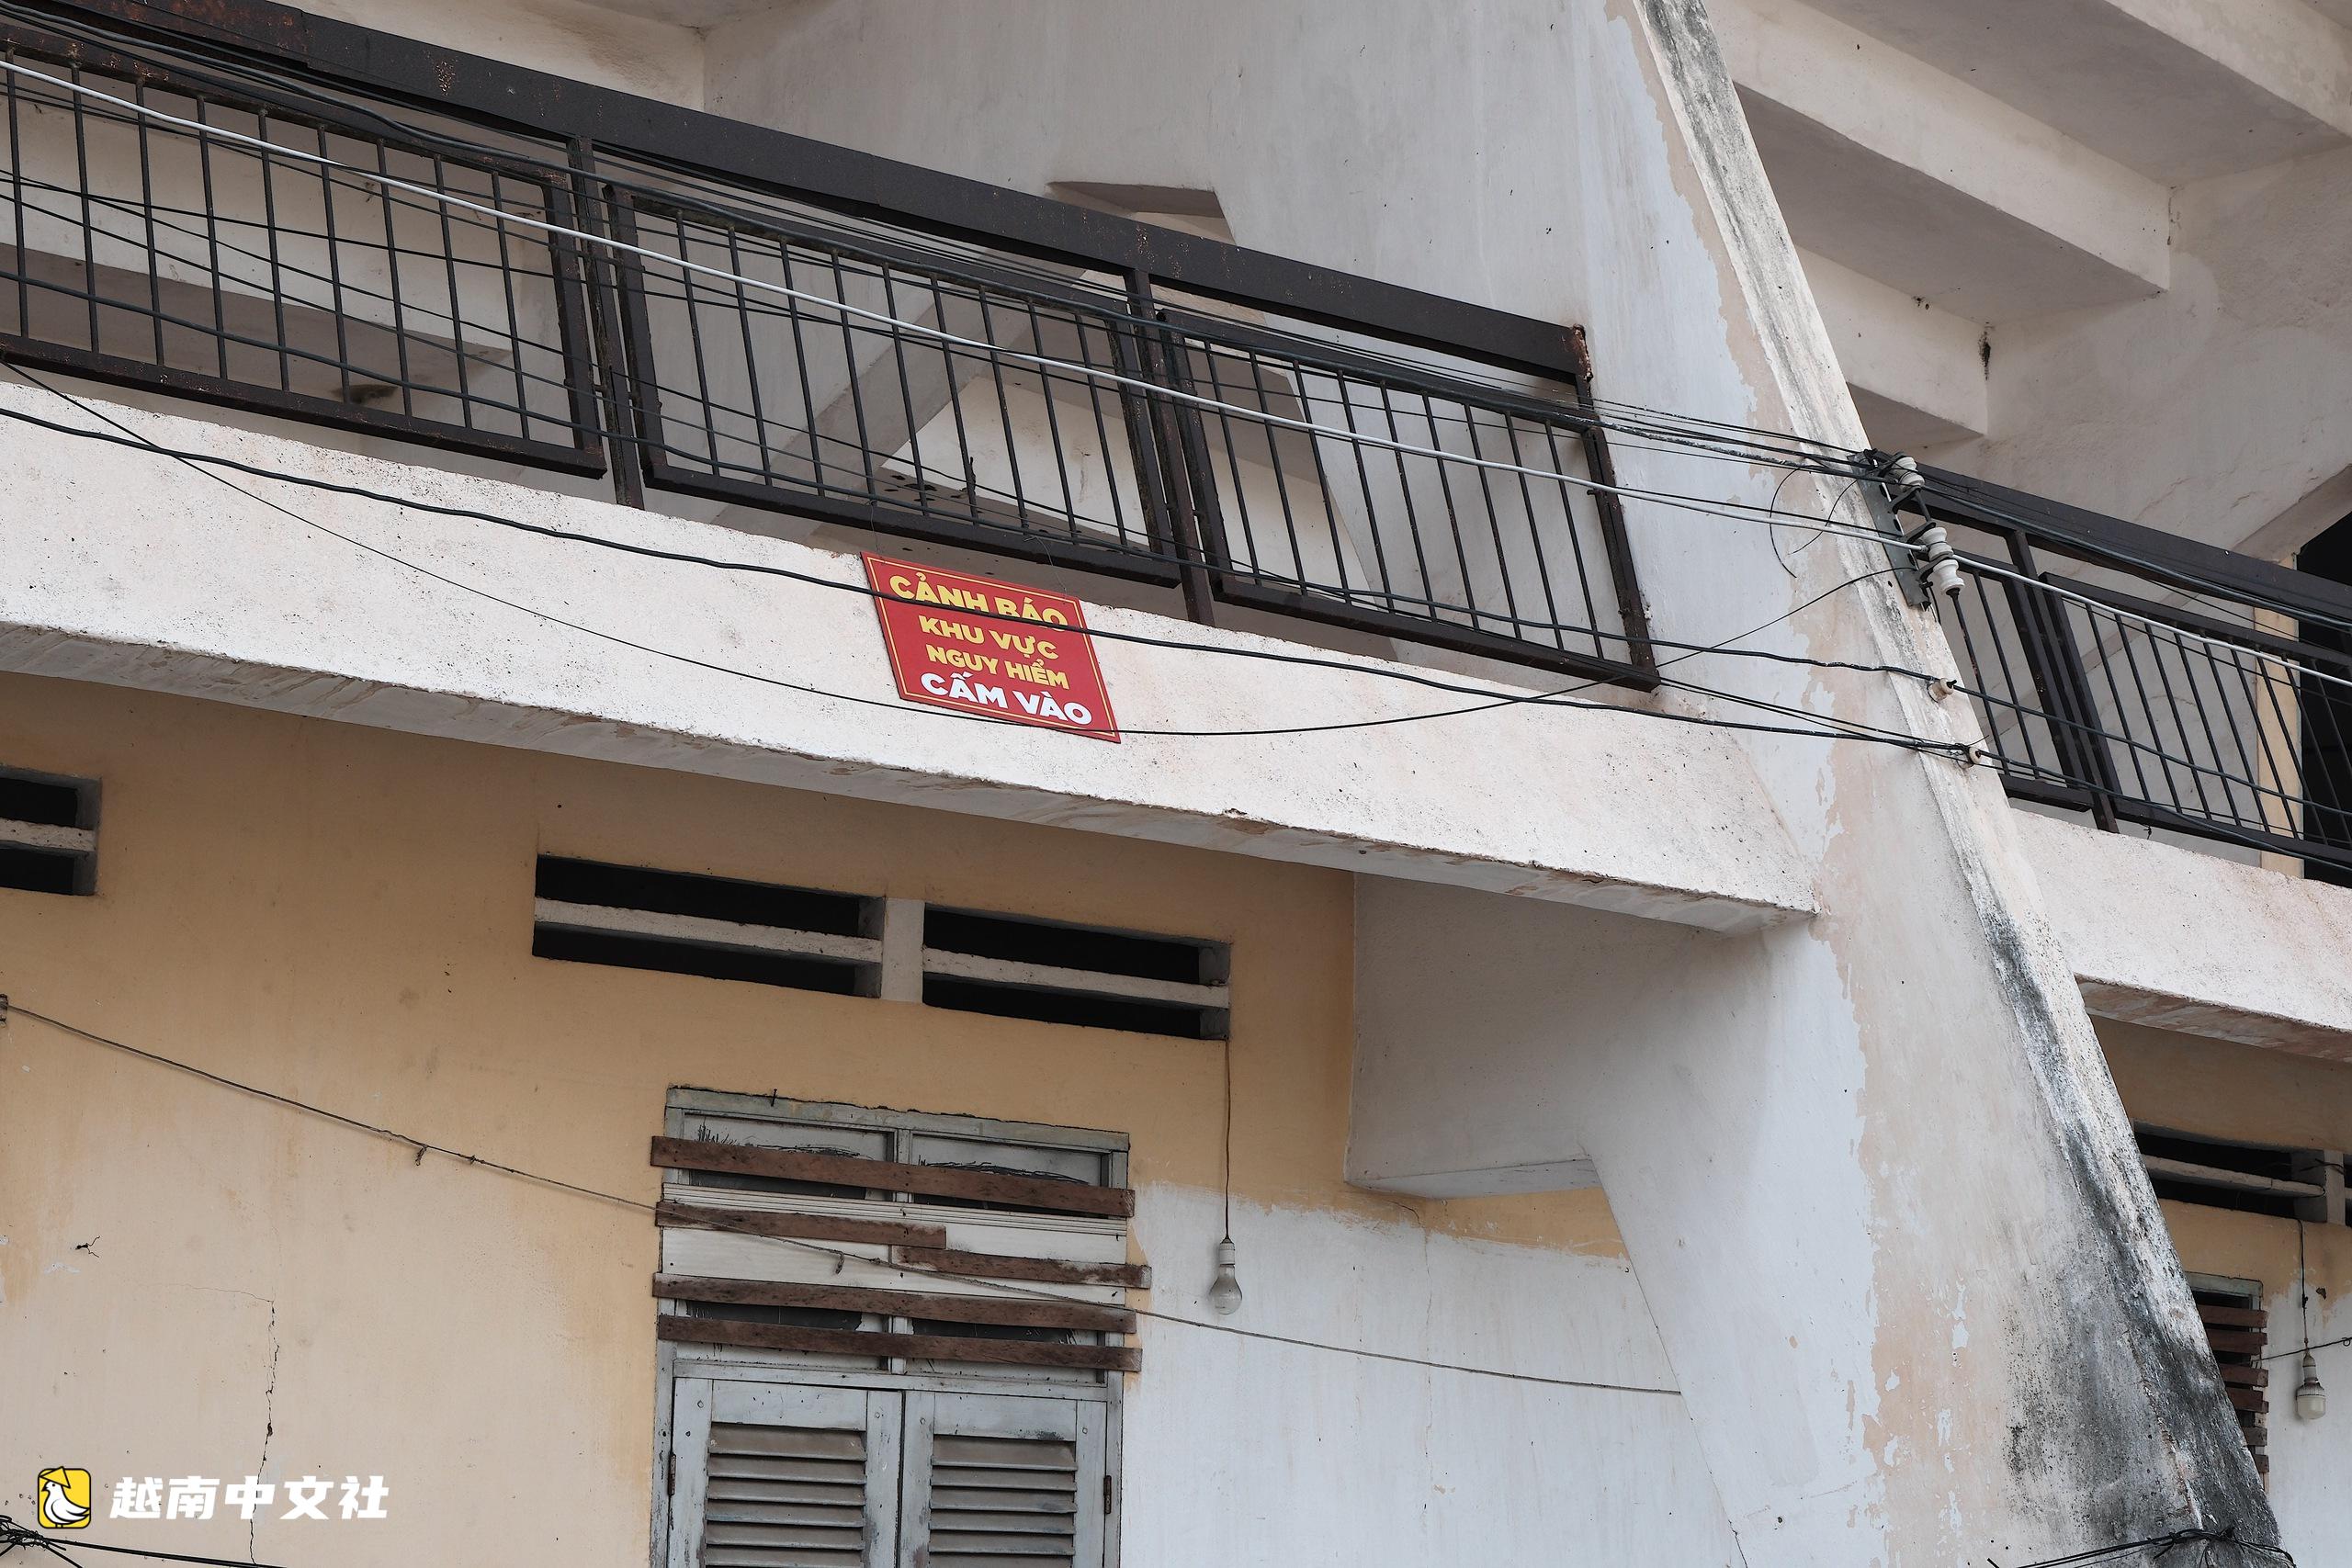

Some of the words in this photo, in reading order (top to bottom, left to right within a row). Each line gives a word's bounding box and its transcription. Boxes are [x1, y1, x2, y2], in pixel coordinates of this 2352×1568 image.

[889, 571, 989, 613] CẢNH
[991, 597, 1069, 632] BÁO
[918, 615, 985, 644] KHU
[989, 629, 1060, 660] VỰC
[925, 644, 999, 675] NGUY
[1004, 659, 1070, 690] HIỂM
[921, 671, 1009, 709] CẤM
[1012, 691, 1092, 725] VÀO
